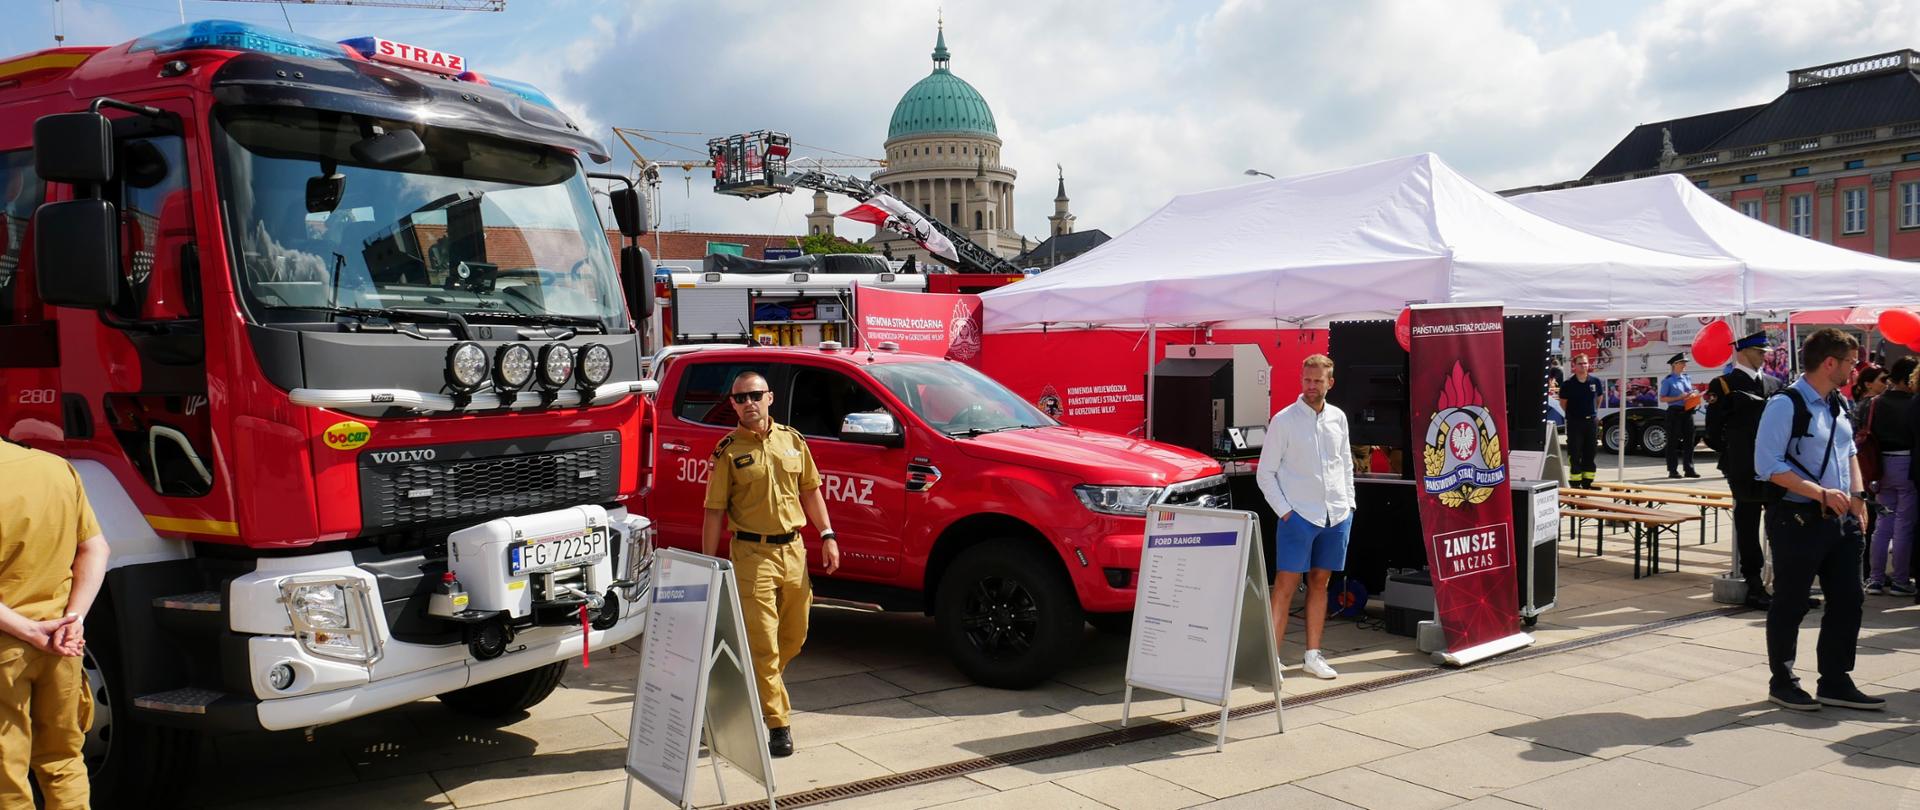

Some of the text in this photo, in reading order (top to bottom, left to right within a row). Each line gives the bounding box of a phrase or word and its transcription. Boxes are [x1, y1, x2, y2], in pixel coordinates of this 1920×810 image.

[1412, 321, 1502, 335] PAŃSTWOWA STRAŻ POŻARNA
[1570, 322, 1623, 338] Spiel- und
[1571, 337, 1622, 350] Info-Mobi
[19, 389, 56, 404] 280
[327, 431, 369, 444] bocar
[604, 434, 616, 444] FL
[370, 448, 436, 464] VOLVO
[1154, 536, 1201, 545] FORD RANGER
[1444, 531, 1496, 558] ZAWSZE
[524, 544, 546, 568] FG
[553, 533, 602, 562] 7225P
[1453, 553, 1493, 572] NA CZAS
